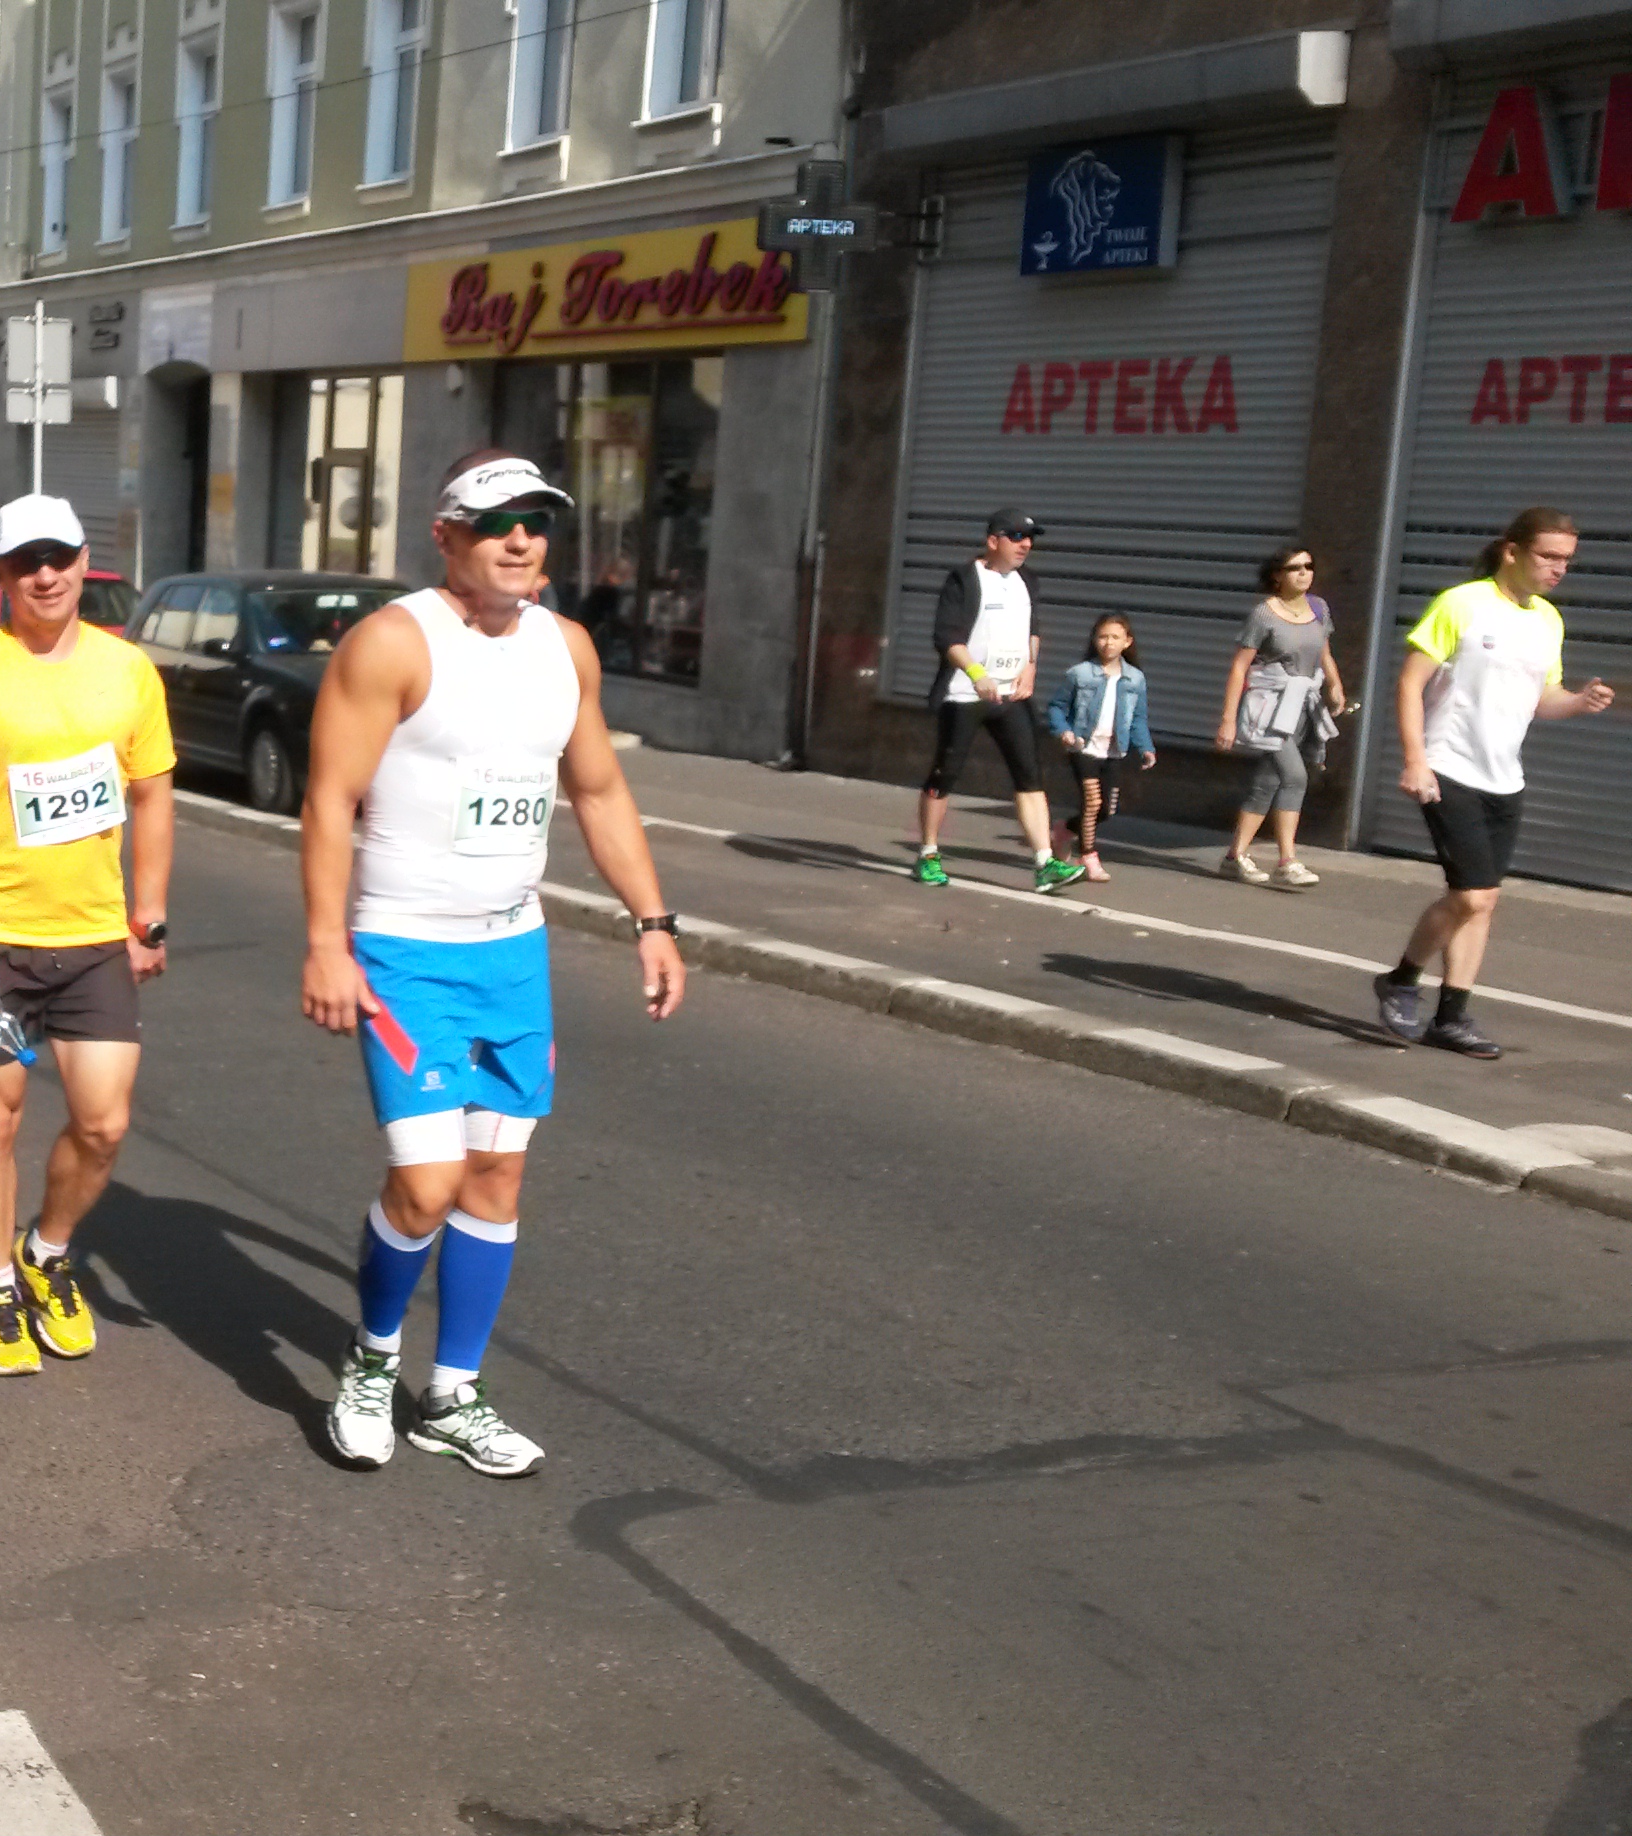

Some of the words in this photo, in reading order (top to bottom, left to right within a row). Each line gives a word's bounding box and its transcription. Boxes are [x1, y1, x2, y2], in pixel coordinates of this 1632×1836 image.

[786, 219, 856, 236] APTEKA
[441, 262, 546, 354] Raj
[560, 232, 791, 326] Torebek
[1000, 355, 1239, 434] APTEKA
[996, 657, 1021, 669] 987
[22, 771, 44, 786] 16
[25, 781, 110, 822] 1292
[468, 797, 547, 826] 1280
